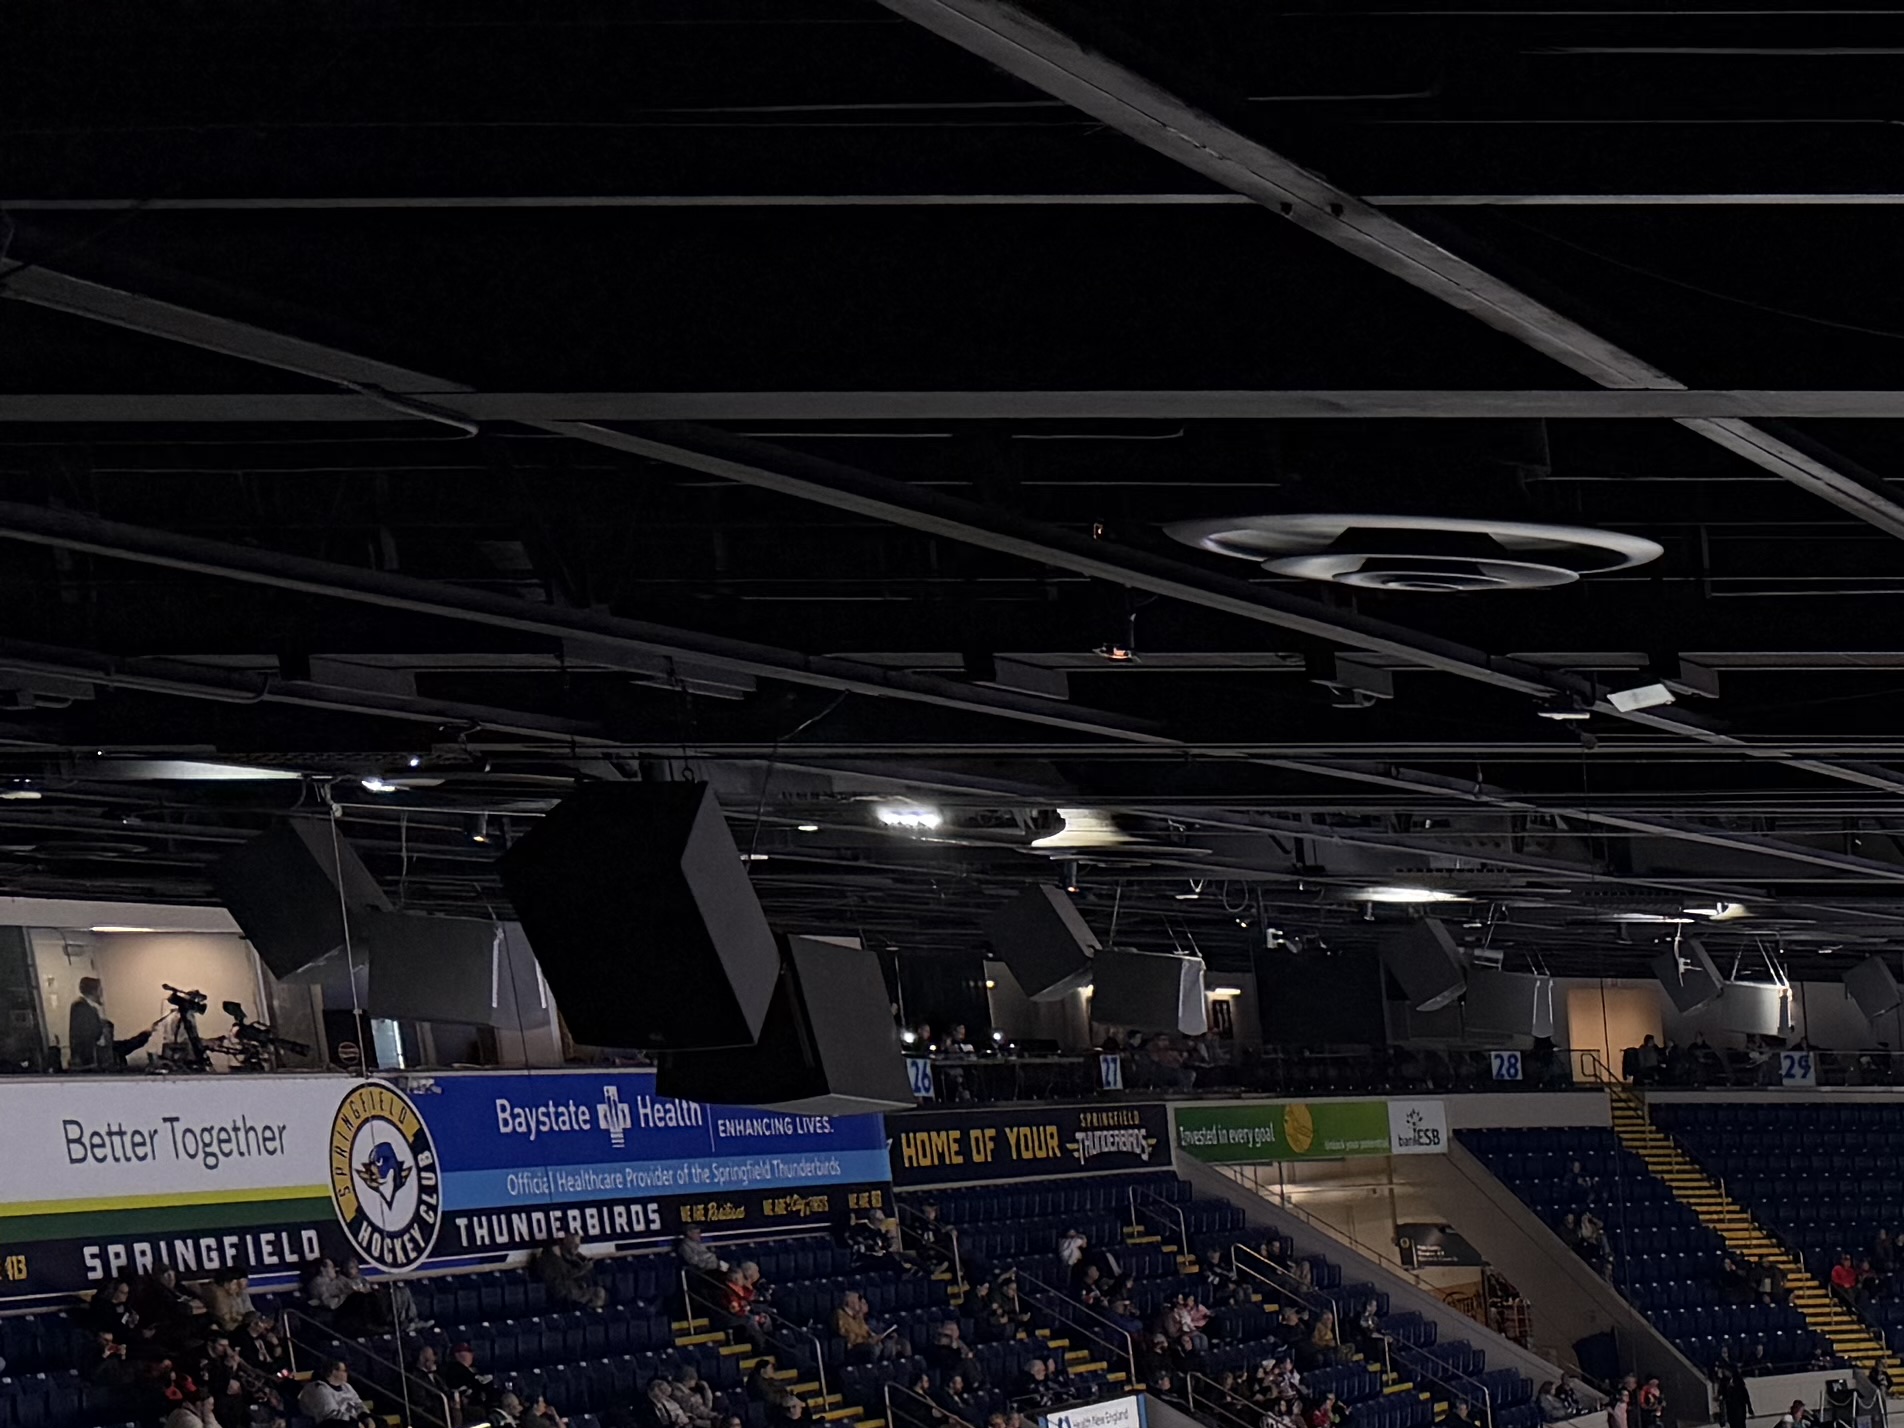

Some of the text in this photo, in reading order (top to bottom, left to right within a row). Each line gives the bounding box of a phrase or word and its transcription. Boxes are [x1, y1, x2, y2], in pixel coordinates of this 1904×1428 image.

[910, 1060, 931, 1094] 26
[1494, 1053, 1519, 1079] 28
[1782, 1054, 1812, 1079] 29
[495, 1096, 703, 1141] Baystate Health
[719, 1115, 835, 1138] ENHANCING LIVES.
[1080, 1110, 1140, 1128] SPRINGFIELD
[1179, 1121, 1275, 1148] Invested in every goal
[62, 1115, 287, 1170] Better Together
[334, 1091, 407, 1197] SPRINGFIELD
[901, 1125, 1062, 1168] HOME OF YOUR
[1074, 1128, 1150, 1165] THUNDERBIRDS
[418, 1150, 438, 1224] CLUB
[507, 1158, 842, 1196] Official Healthcare Provider of the Springfield Thunderbirds
[83, 1229, 321, 1280] SPRINGFIELD
[456, 1203, 661, 1247] THUNDERBIRDS
[358, 1221, 425, 1263] HOCKEY
